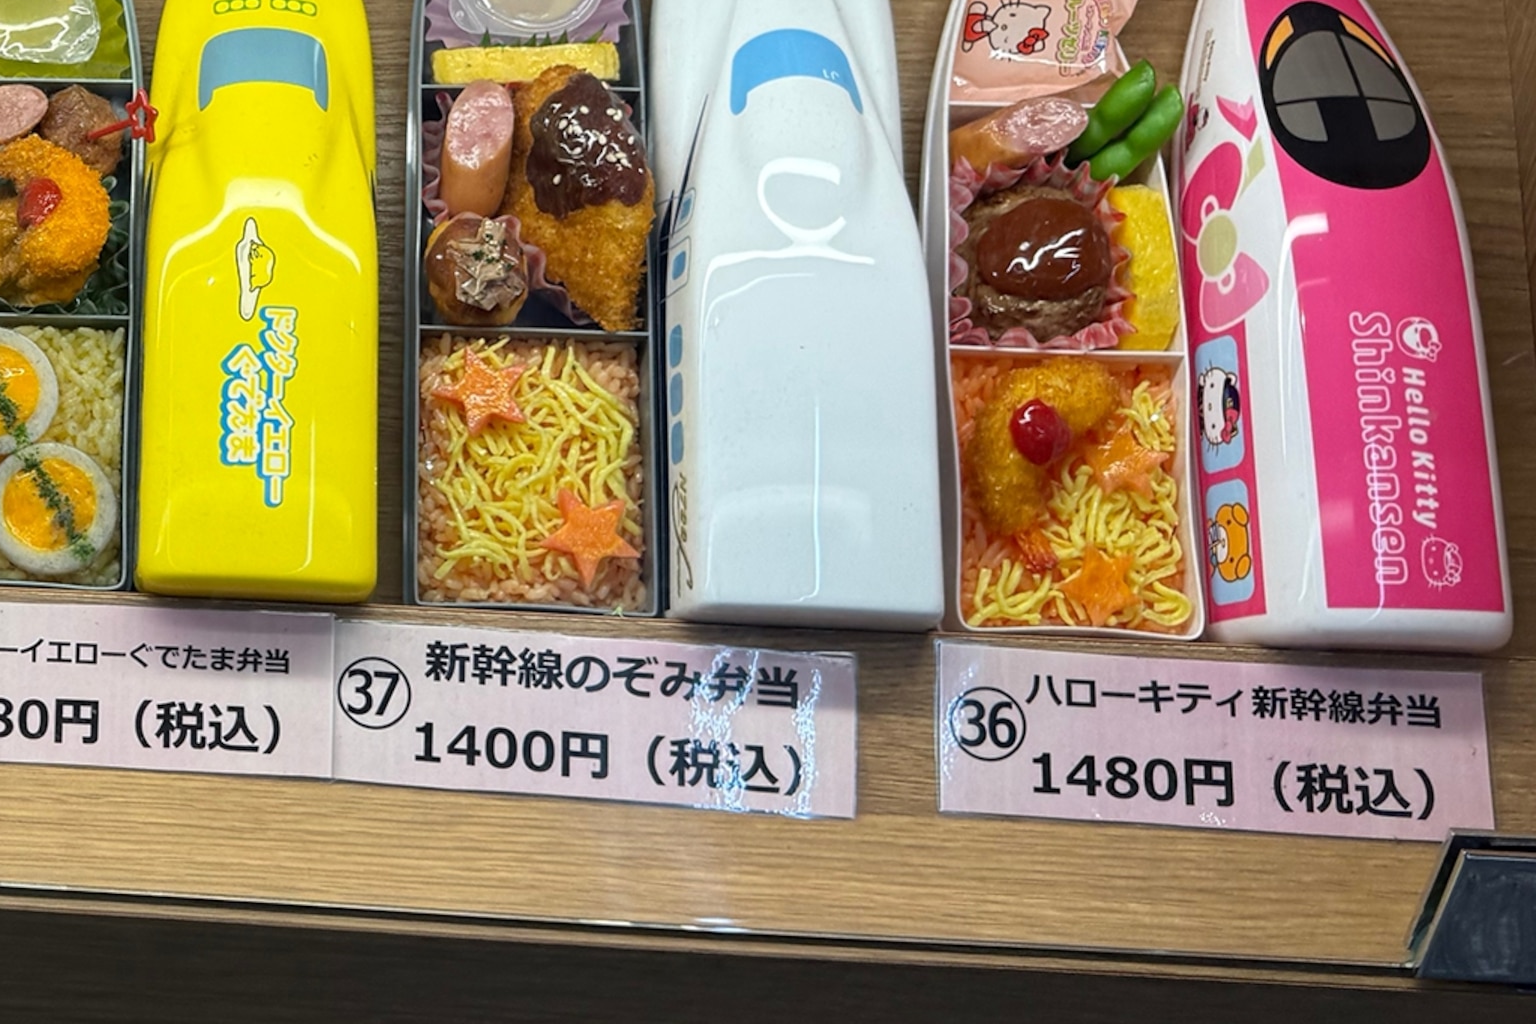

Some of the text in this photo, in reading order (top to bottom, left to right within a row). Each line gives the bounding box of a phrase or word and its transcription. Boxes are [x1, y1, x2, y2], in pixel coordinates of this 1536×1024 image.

[221, 345, 266, 465] ぐでたま
[261, 307, 297, 507] ドクターイエロー
[1348, 310, 1411, 587] Shinkansen
[1402, 366, 1441, 528] Hello Kitty
[424, 639, 799, 710] 新幹線のぞみ弁当
